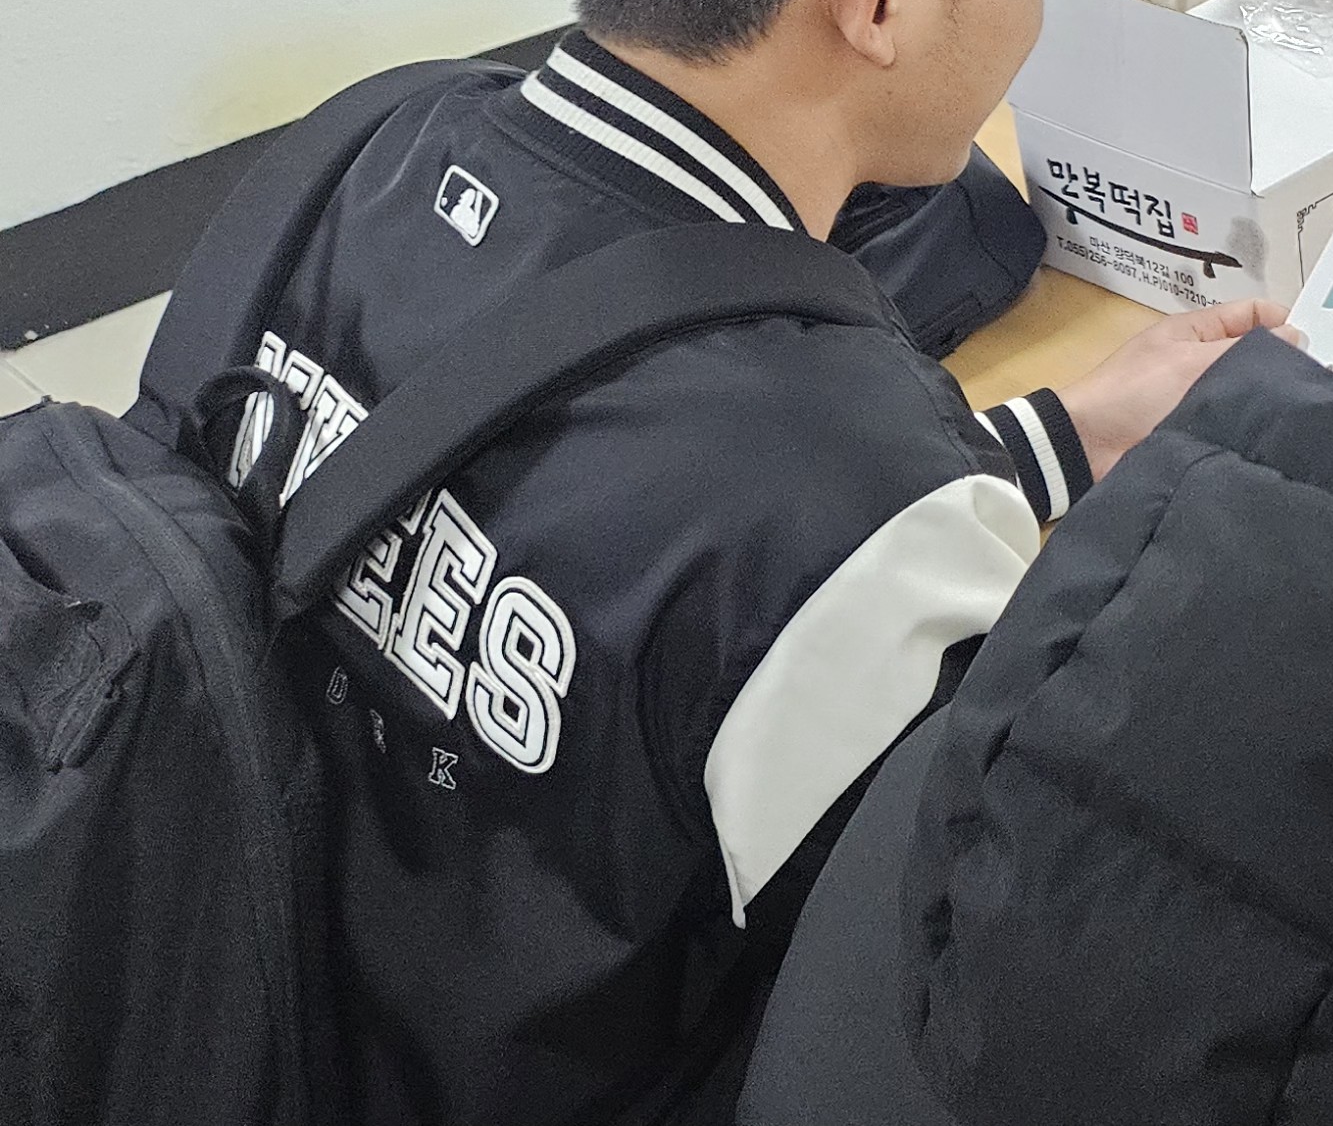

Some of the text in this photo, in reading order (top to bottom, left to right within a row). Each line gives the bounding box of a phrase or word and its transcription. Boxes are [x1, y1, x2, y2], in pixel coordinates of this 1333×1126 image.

[1047, 158, 1175, 239] 만복떡집
[1089, 236, 1112, 255] 마산
[1174, 270, 1195, 287] 100
